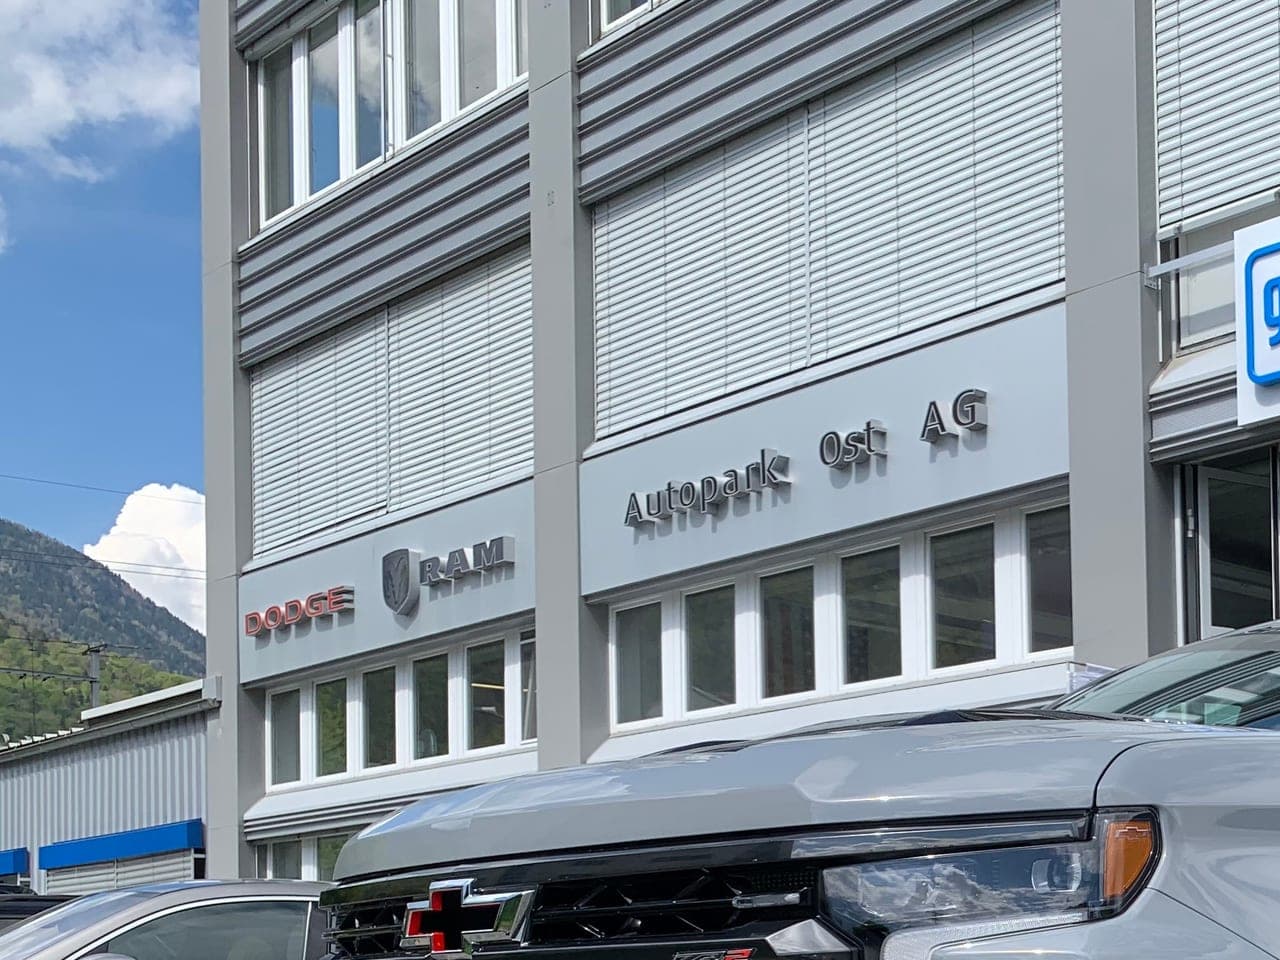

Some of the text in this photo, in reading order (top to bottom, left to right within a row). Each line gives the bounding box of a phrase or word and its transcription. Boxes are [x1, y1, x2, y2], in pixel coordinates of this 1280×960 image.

[624, 388, 986, 527] Autopark Ost AG
[419, 536, 511, 586] RAM
[244, 585, 352, 637] DODGE
